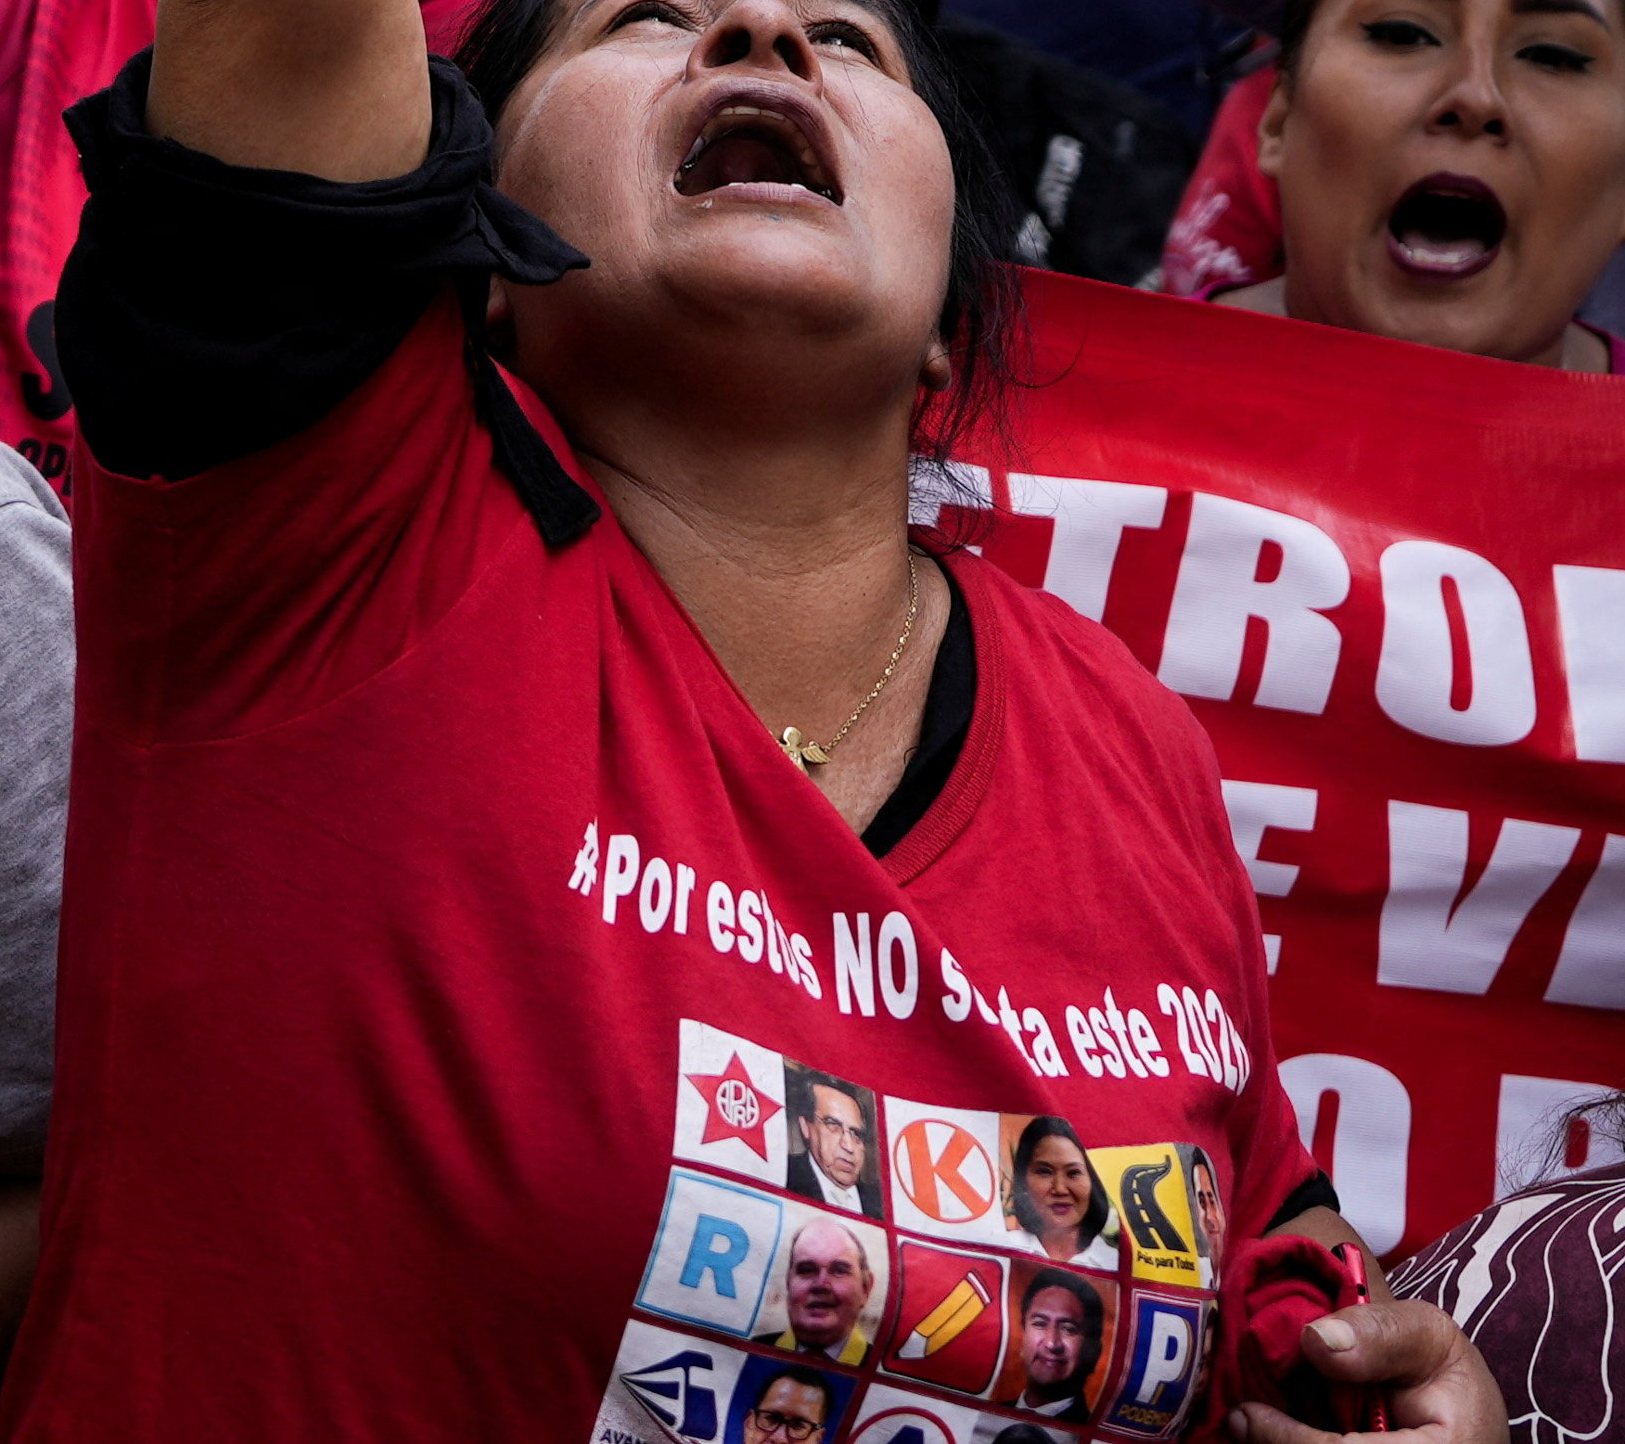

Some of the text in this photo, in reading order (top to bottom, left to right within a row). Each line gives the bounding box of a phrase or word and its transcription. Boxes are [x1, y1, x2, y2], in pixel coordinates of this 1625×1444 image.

[707, 881, 822, 1000] estos
[833, 911, 919, 1020] NO
[1065, 985, 1170, 1078] este
[905, 1121, 990, 1221] K
[679, 1213, 749, 1299] R
[1136, 1310, 1191, 1405] P
